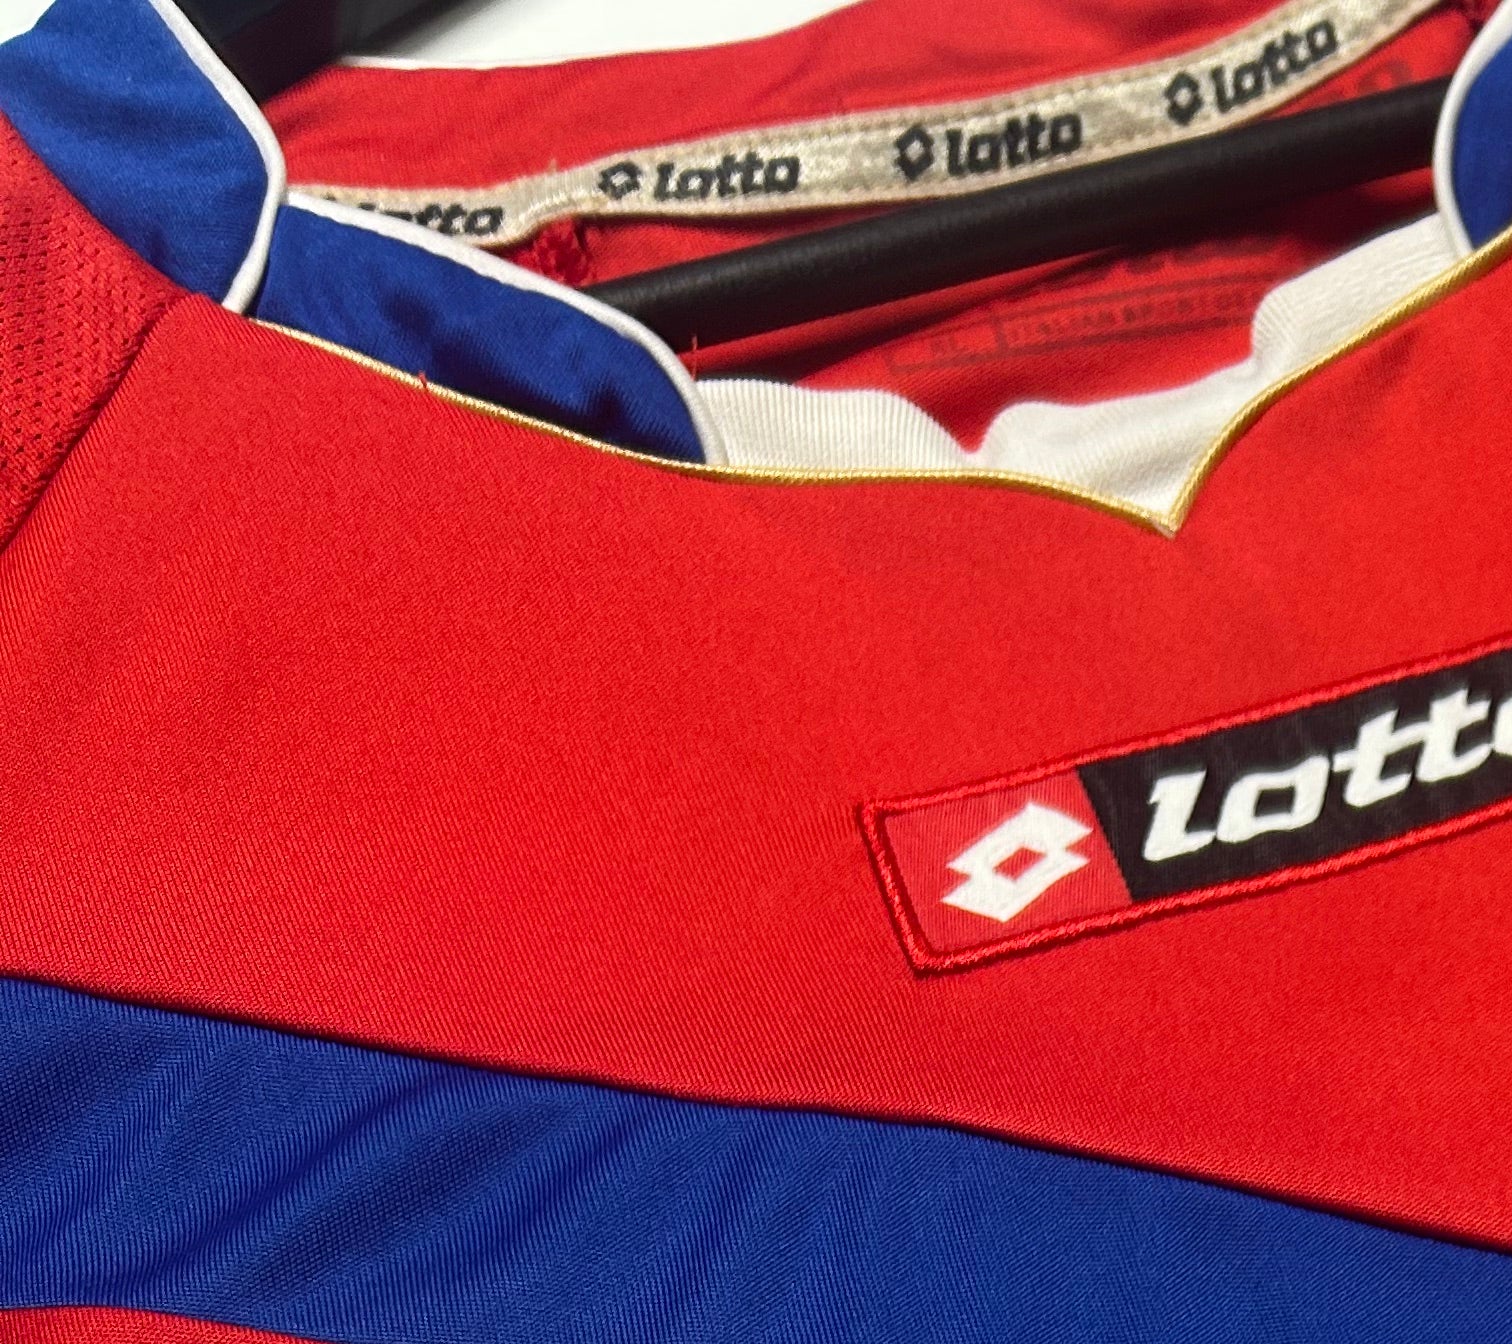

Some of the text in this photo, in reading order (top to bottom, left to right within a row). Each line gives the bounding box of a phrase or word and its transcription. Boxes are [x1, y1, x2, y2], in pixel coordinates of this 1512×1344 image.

[1208, 18, 1338, 114] lotto
[946, 111, 1083, 176] lotto
[653, 153, 801, 200] lotto
